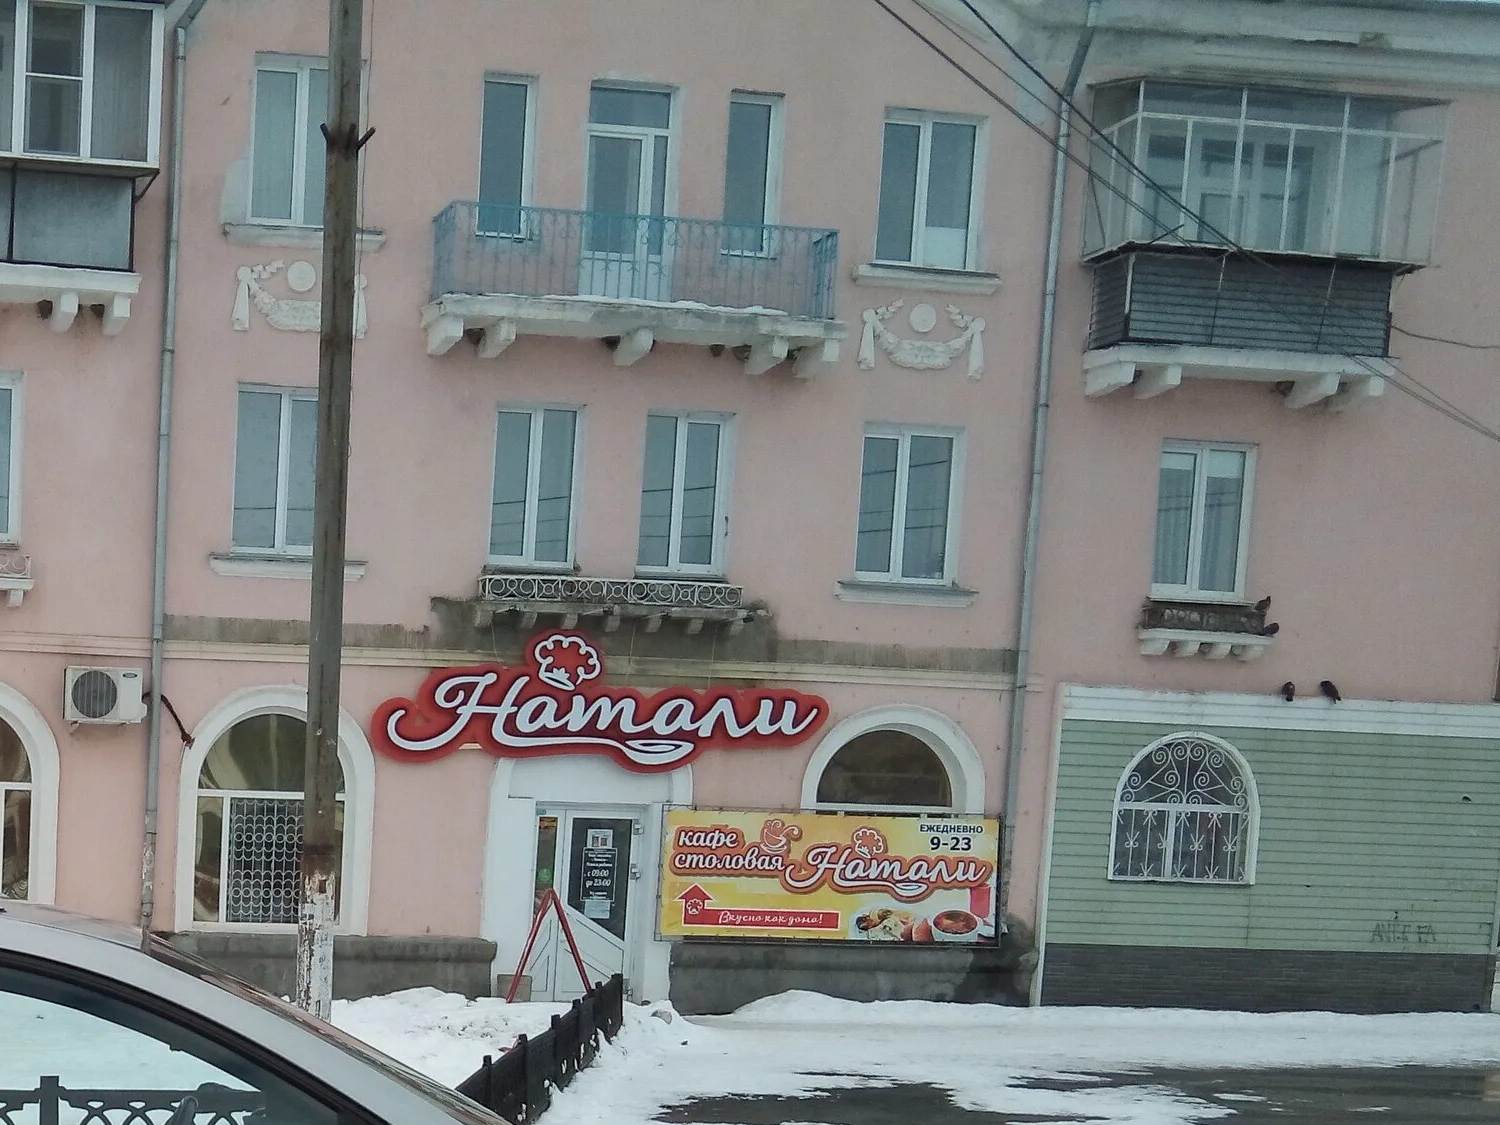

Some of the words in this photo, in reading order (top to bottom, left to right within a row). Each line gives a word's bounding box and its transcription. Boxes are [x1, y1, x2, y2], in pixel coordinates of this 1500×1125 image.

[387, 671, 818, 765] Натали
[920, 823, 984, 834] ЕЖЕДНЕВНО
[678, 829, 738, 849] кафе
[930, 836, 972, 851] 9-23
[674, 847, 786, 871] столовая
[785, 846, 986, 897] Натали
[718, 911, 763, 924] Вкусно
[764, 914, 787, 924] как
